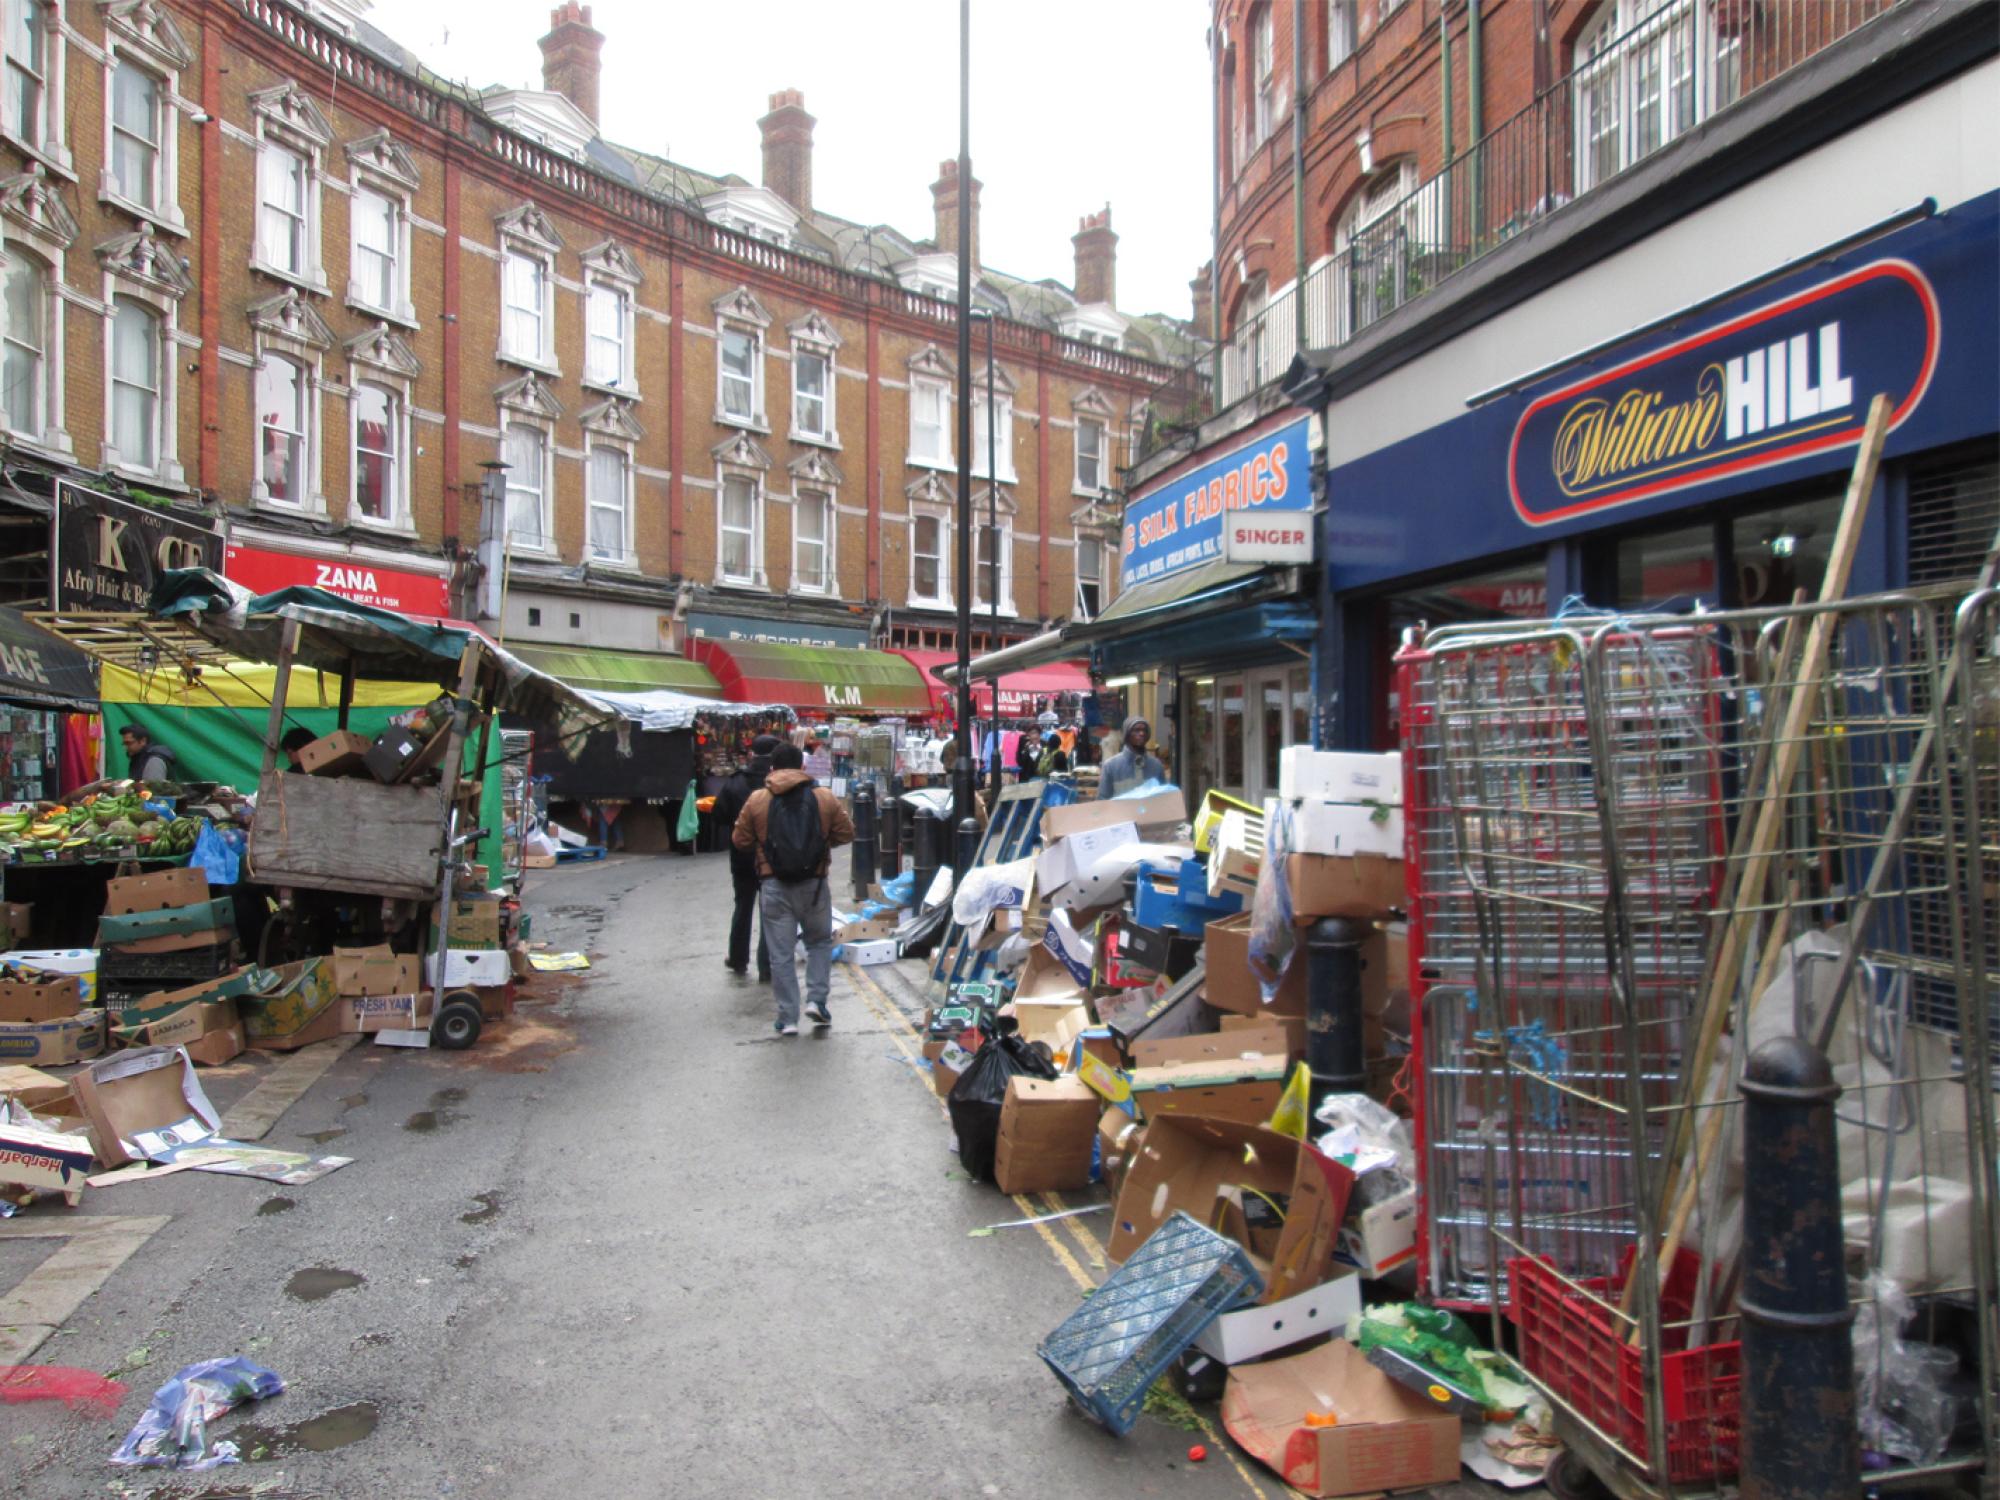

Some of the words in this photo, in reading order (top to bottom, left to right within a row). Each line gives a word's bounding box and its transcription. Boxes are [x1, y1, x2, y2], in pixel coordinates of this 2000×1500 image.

[1553, 362, 1727, 490] William
[1725, 321, 1853, 442] HILL
[1139, 502, 1179, 548] SILK
[1184, 441, 1288, 528] FABRICS
[1234, 529, 1305, 545] SINGER
[64, 568, 93, 593] Afro
[96, 574, 119, 599] Hair
[316, 564, 377, 592] ZANA
[824, 685, 862, 705] K.M
